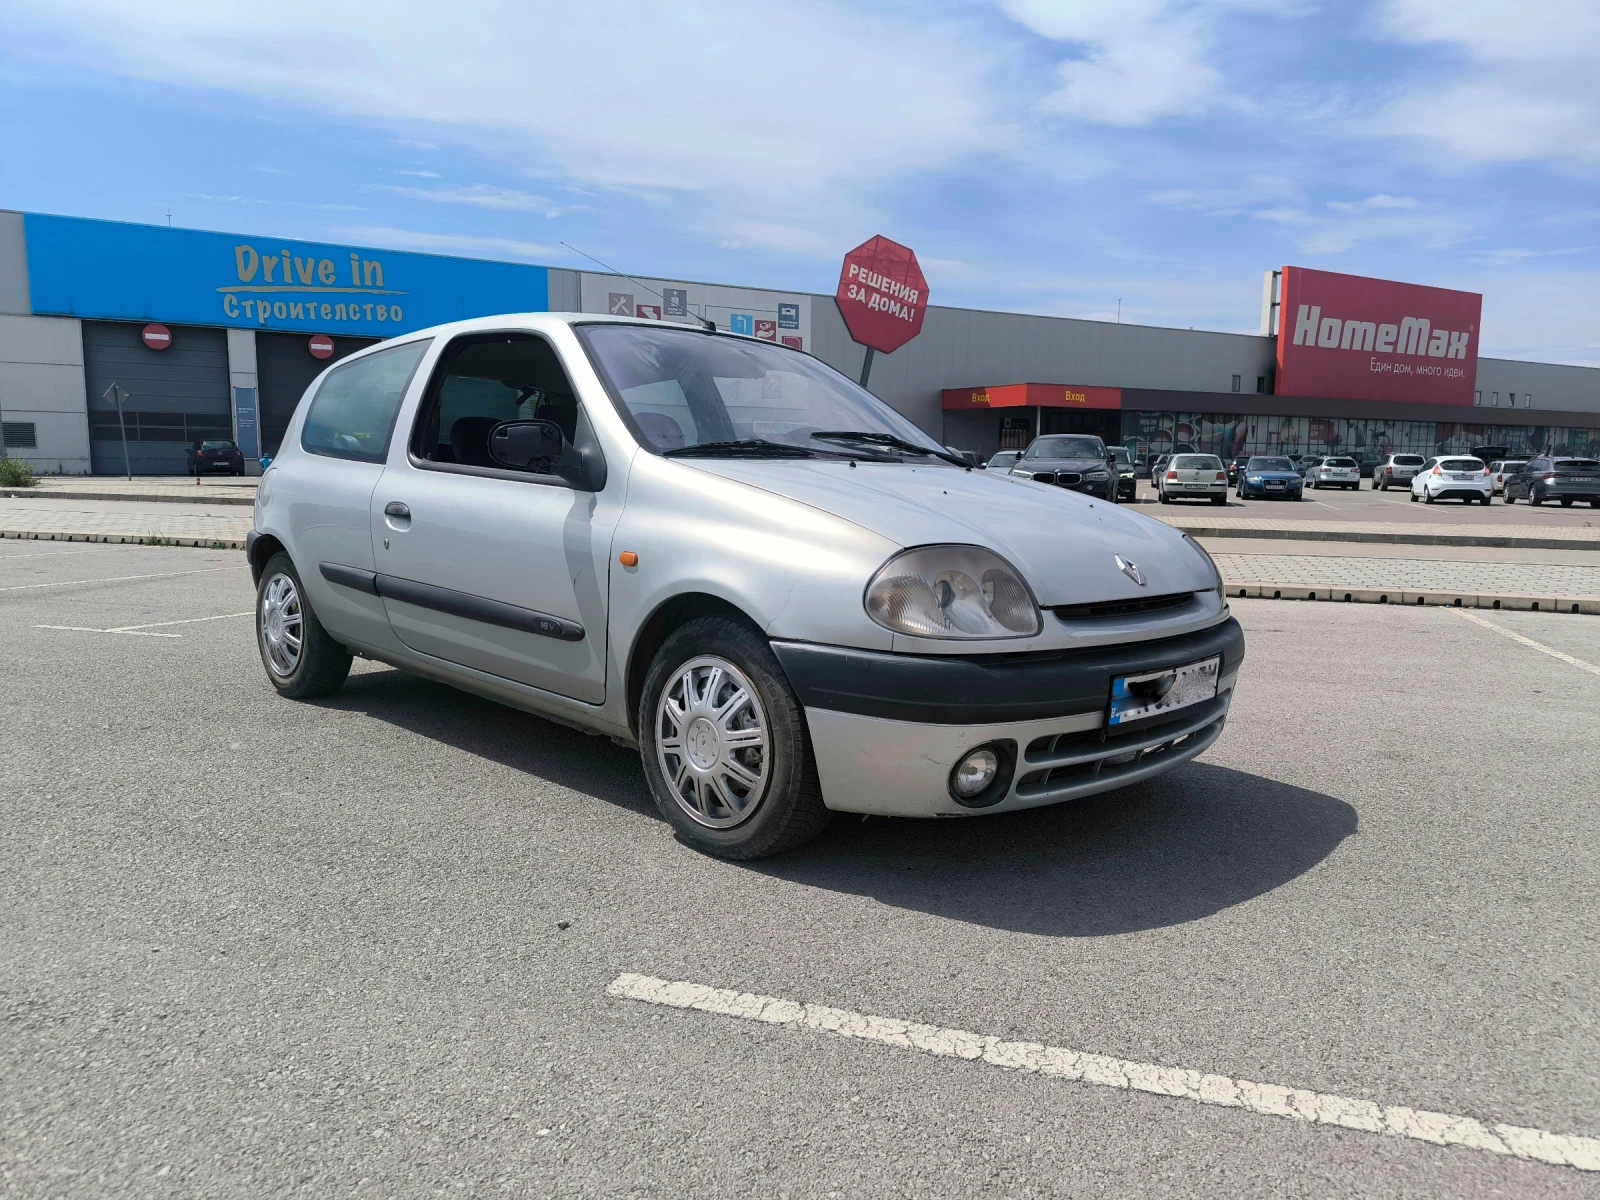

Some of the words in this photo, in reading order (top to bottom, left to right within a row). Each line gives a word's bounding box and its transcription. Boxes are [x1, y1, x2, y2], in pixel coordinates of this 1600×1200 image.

[235, 245, 336, 285] Drive
[350, 253, 384, 287] in
[848, 263, 919, 304] РЕШЕНИЯ
[223, 294, 403, 324] Строителство
[847, 284, 866, 304] ЗА
[868, 292, 915, 322] ДОМА!
[1292, 304, 1470, 360] HomeMax
[1370, 357, 1391, 373] Един
[1393, 363, 1413, 376] дом,
[1416, 365, 1441, 376] много
[1443, 367, 1465, 378] идеи.
[971, 393, 990, 403] Вход
[1065, 391, 1085, 402] Вход
[540, 621, 555, 631] 16V
